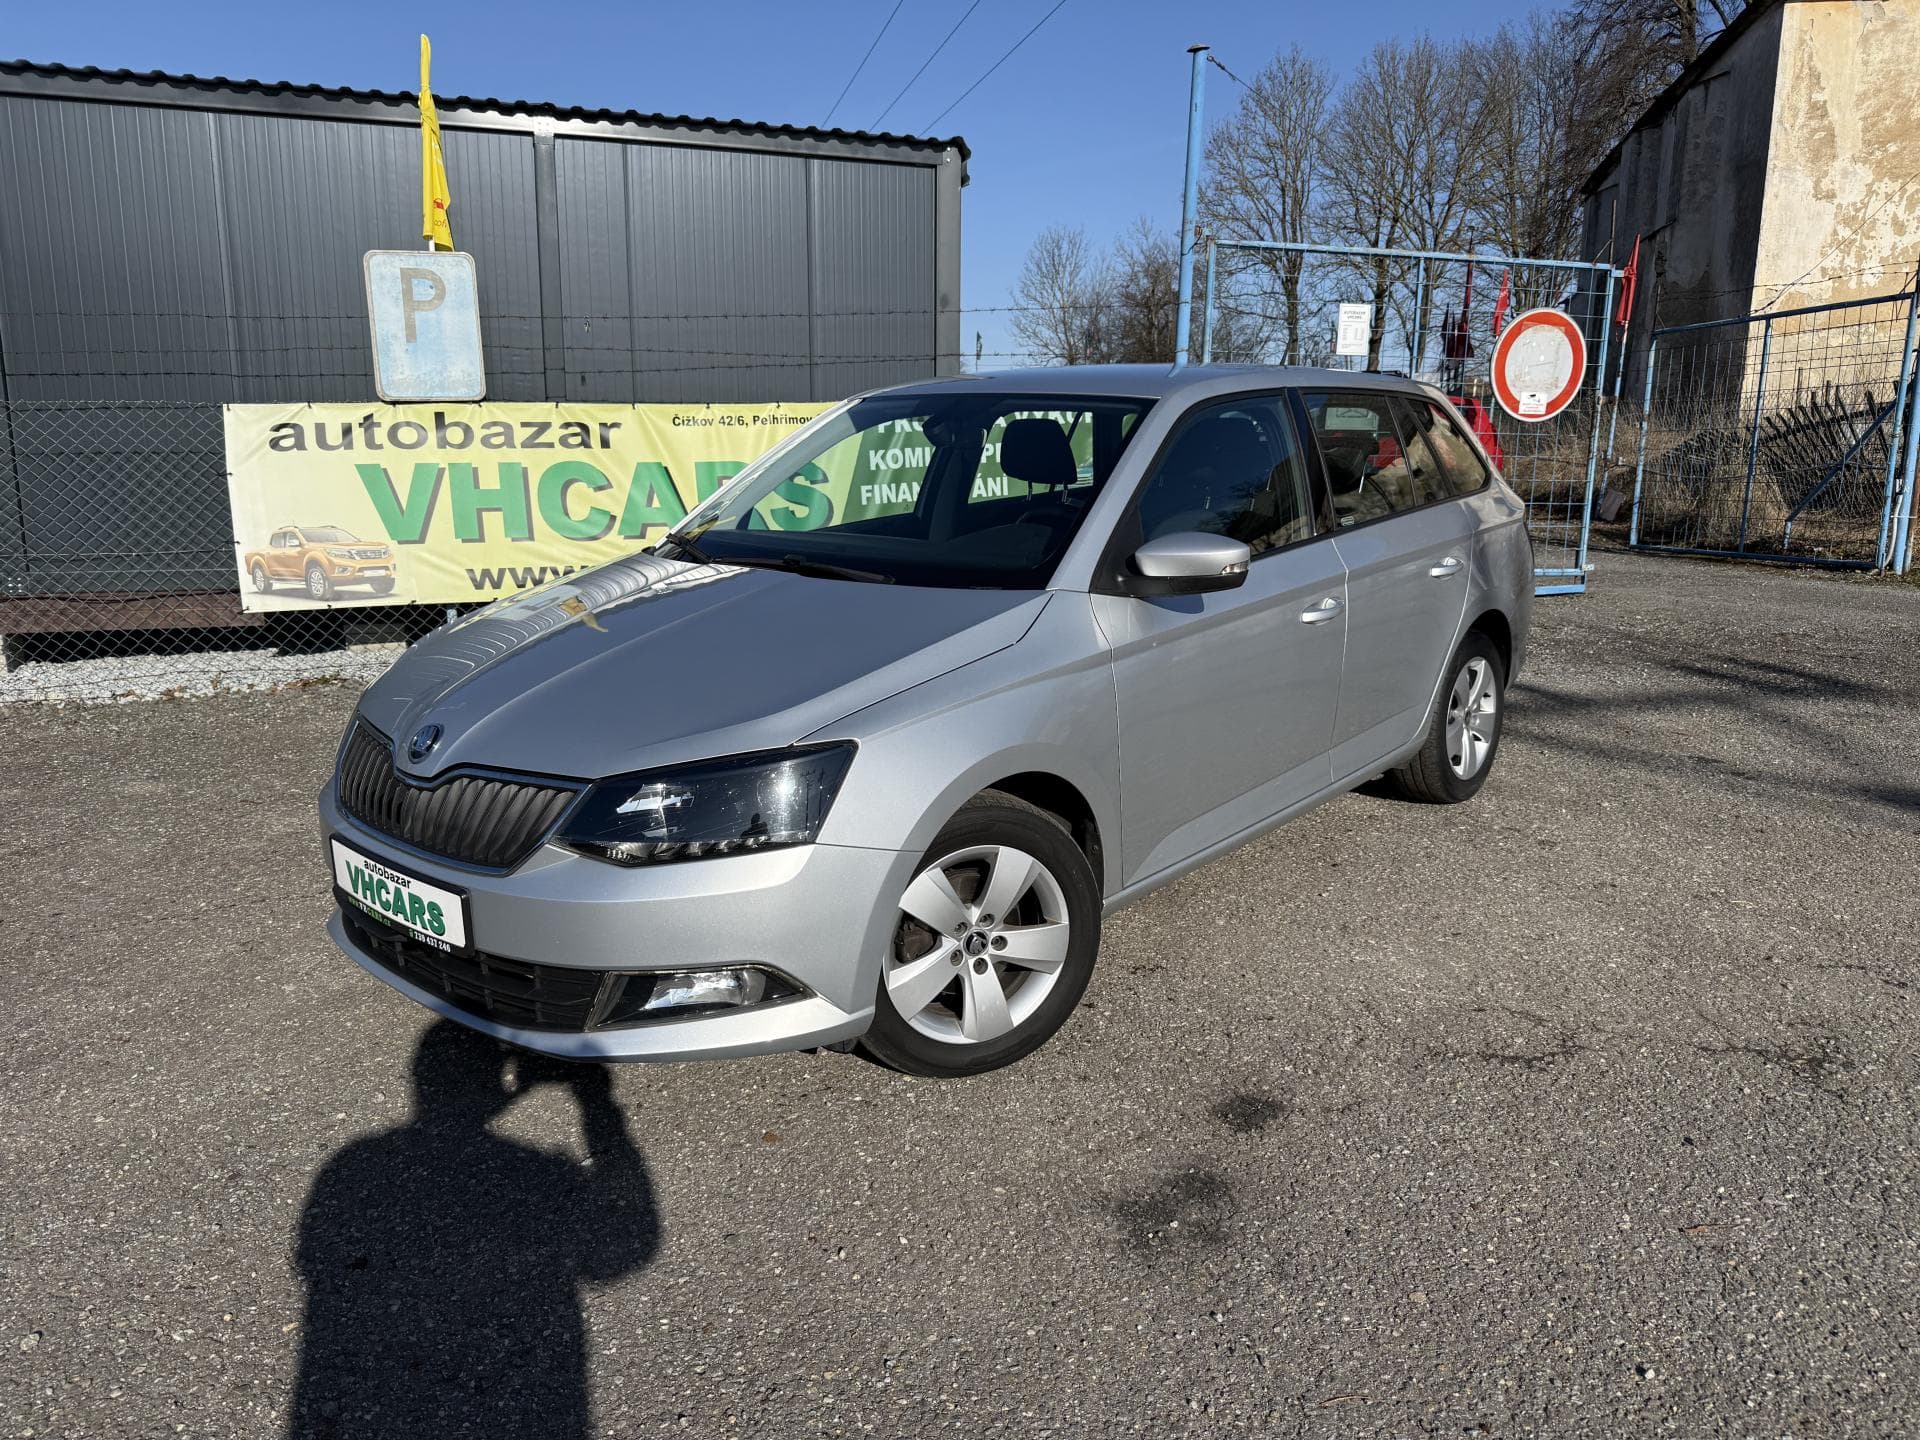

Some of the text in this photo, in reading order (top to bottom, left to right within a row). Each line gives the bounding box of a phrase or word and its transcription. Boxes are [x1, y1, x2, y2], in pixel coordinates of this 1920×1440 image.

[400, 268, 446, 343] P
[268, 411, 622, 451] autobazar
[672, 413, 714, 427] Čížkov
[718, 414, 749, 428] 42/6,
[364, 860, 412, 889] autobazar
[345, 860, 446, 937] VHCARS
